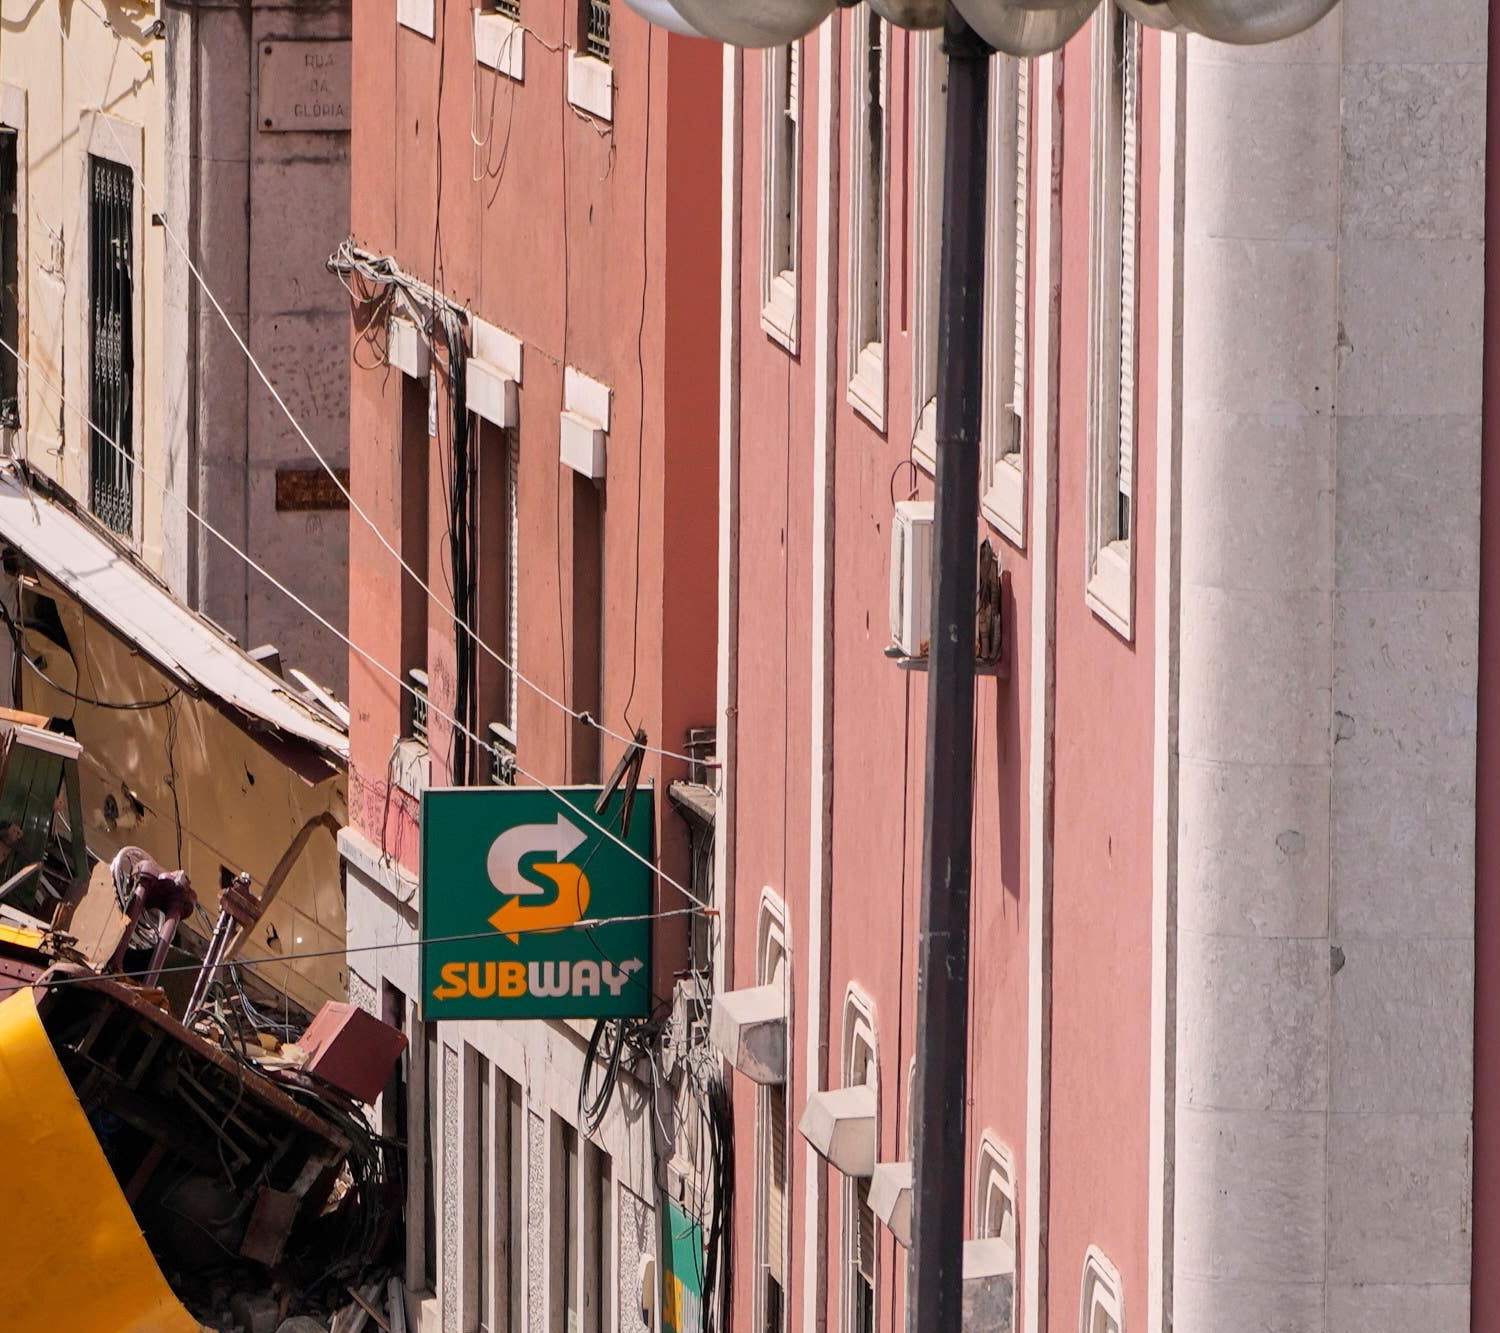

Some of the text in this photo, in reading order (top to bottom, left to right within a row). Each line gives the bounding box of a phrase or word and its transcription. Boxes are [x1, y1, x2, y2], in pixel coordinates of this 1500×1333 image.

[305, 53, 334, 68] RUA
[310, 79, 328, 92] DA
[294, 99, 344, 117] GLÓRIA
[432, 957, 645, 1002] SUBWAY
